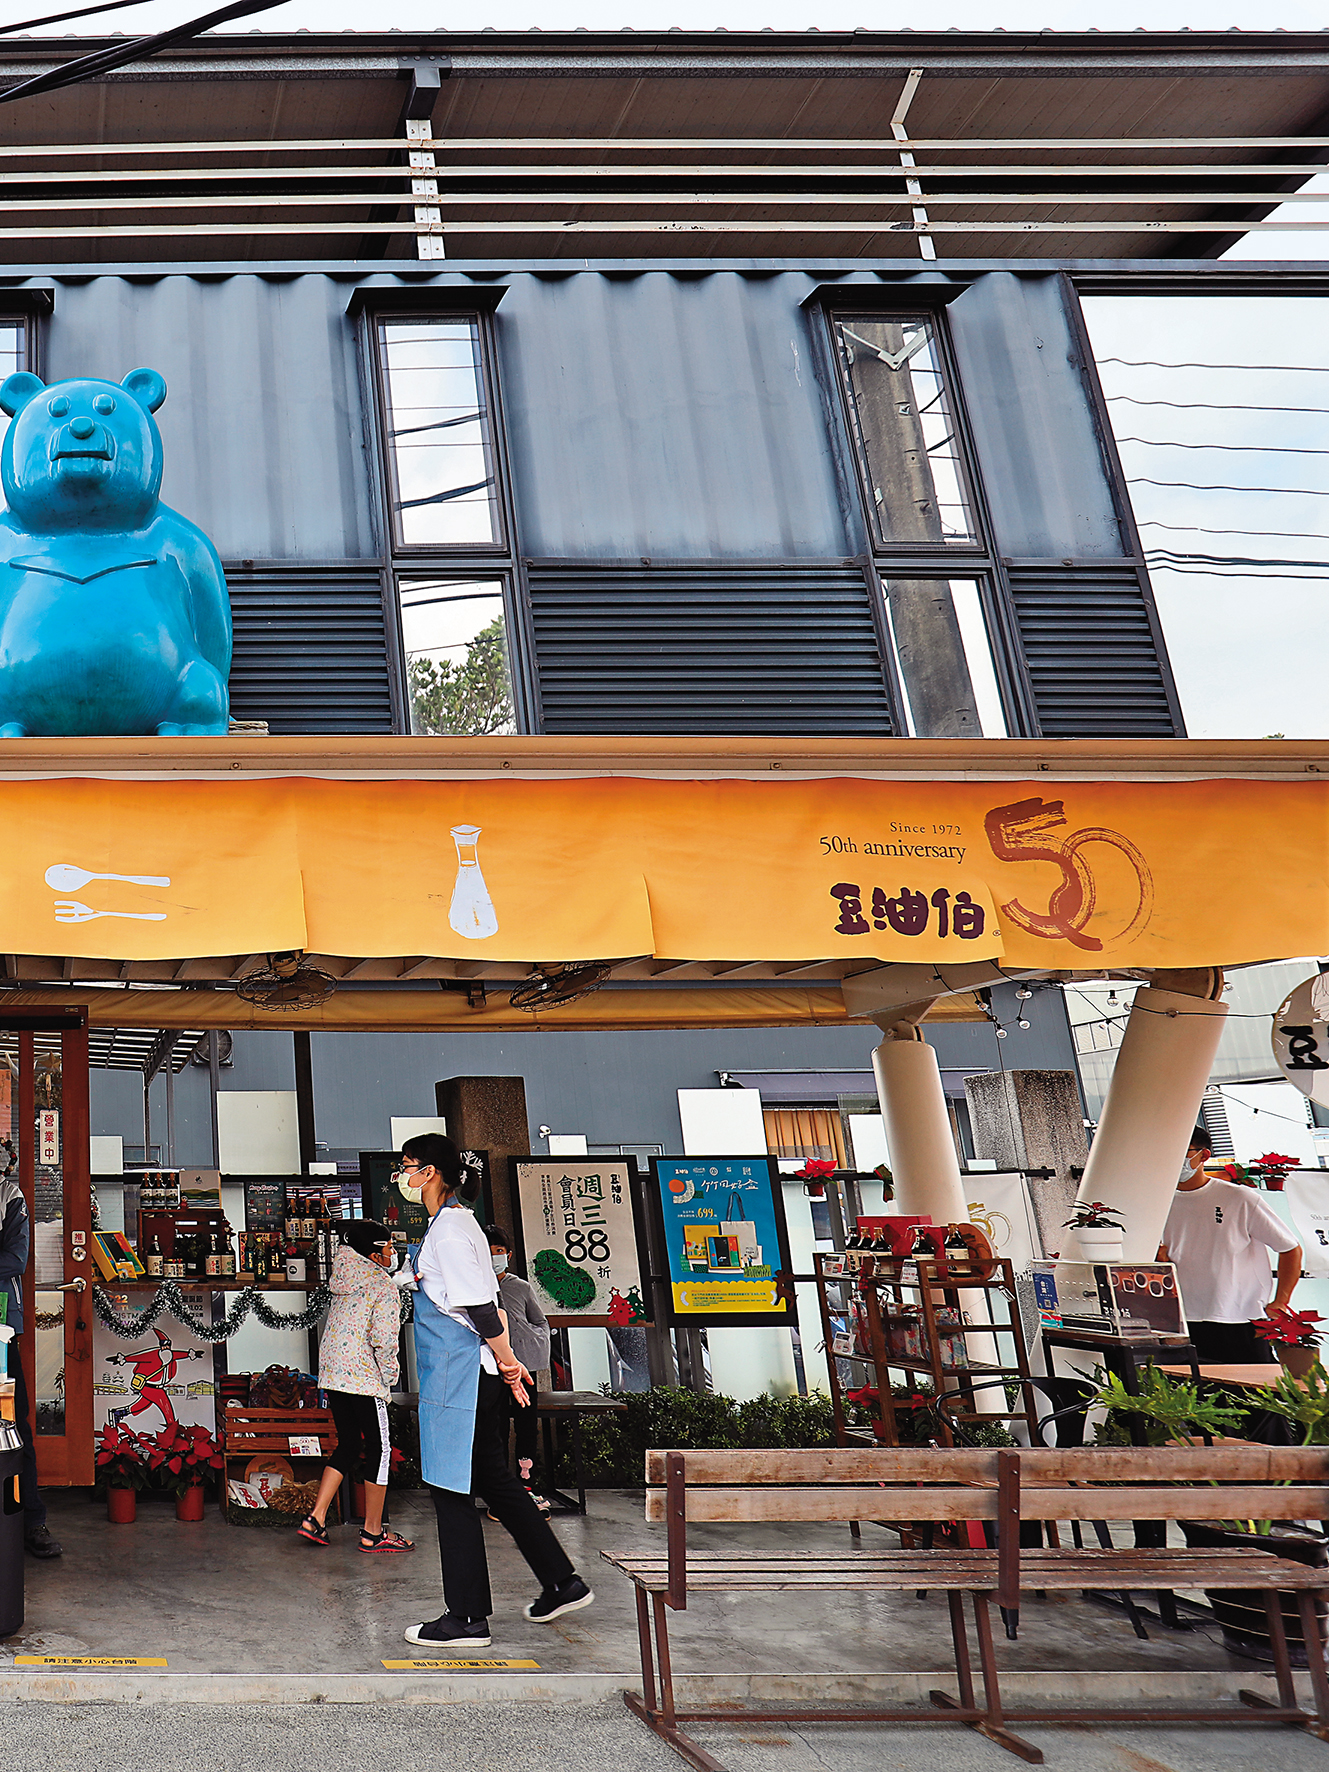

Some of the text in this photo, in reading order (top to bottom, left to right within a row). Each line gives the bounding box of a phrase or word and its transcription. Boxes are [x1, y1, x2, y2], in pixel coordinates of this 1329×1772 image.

[819, 835, 966, 864] 50th anniversary
[890, 821, 962, 836] Since 1972
[829, 882, 985, 940] 豆油伯
[1279, 1025, 1329, 1070] 豆
[44, 1114, 55, 1160] 營業中
[556, 1174, 576, 1227] 會員日
[576, 1173, 607, 1227] 週三
[565, 1229, 611, 1263] 88
[597, 1266, 612, 1279] 折
